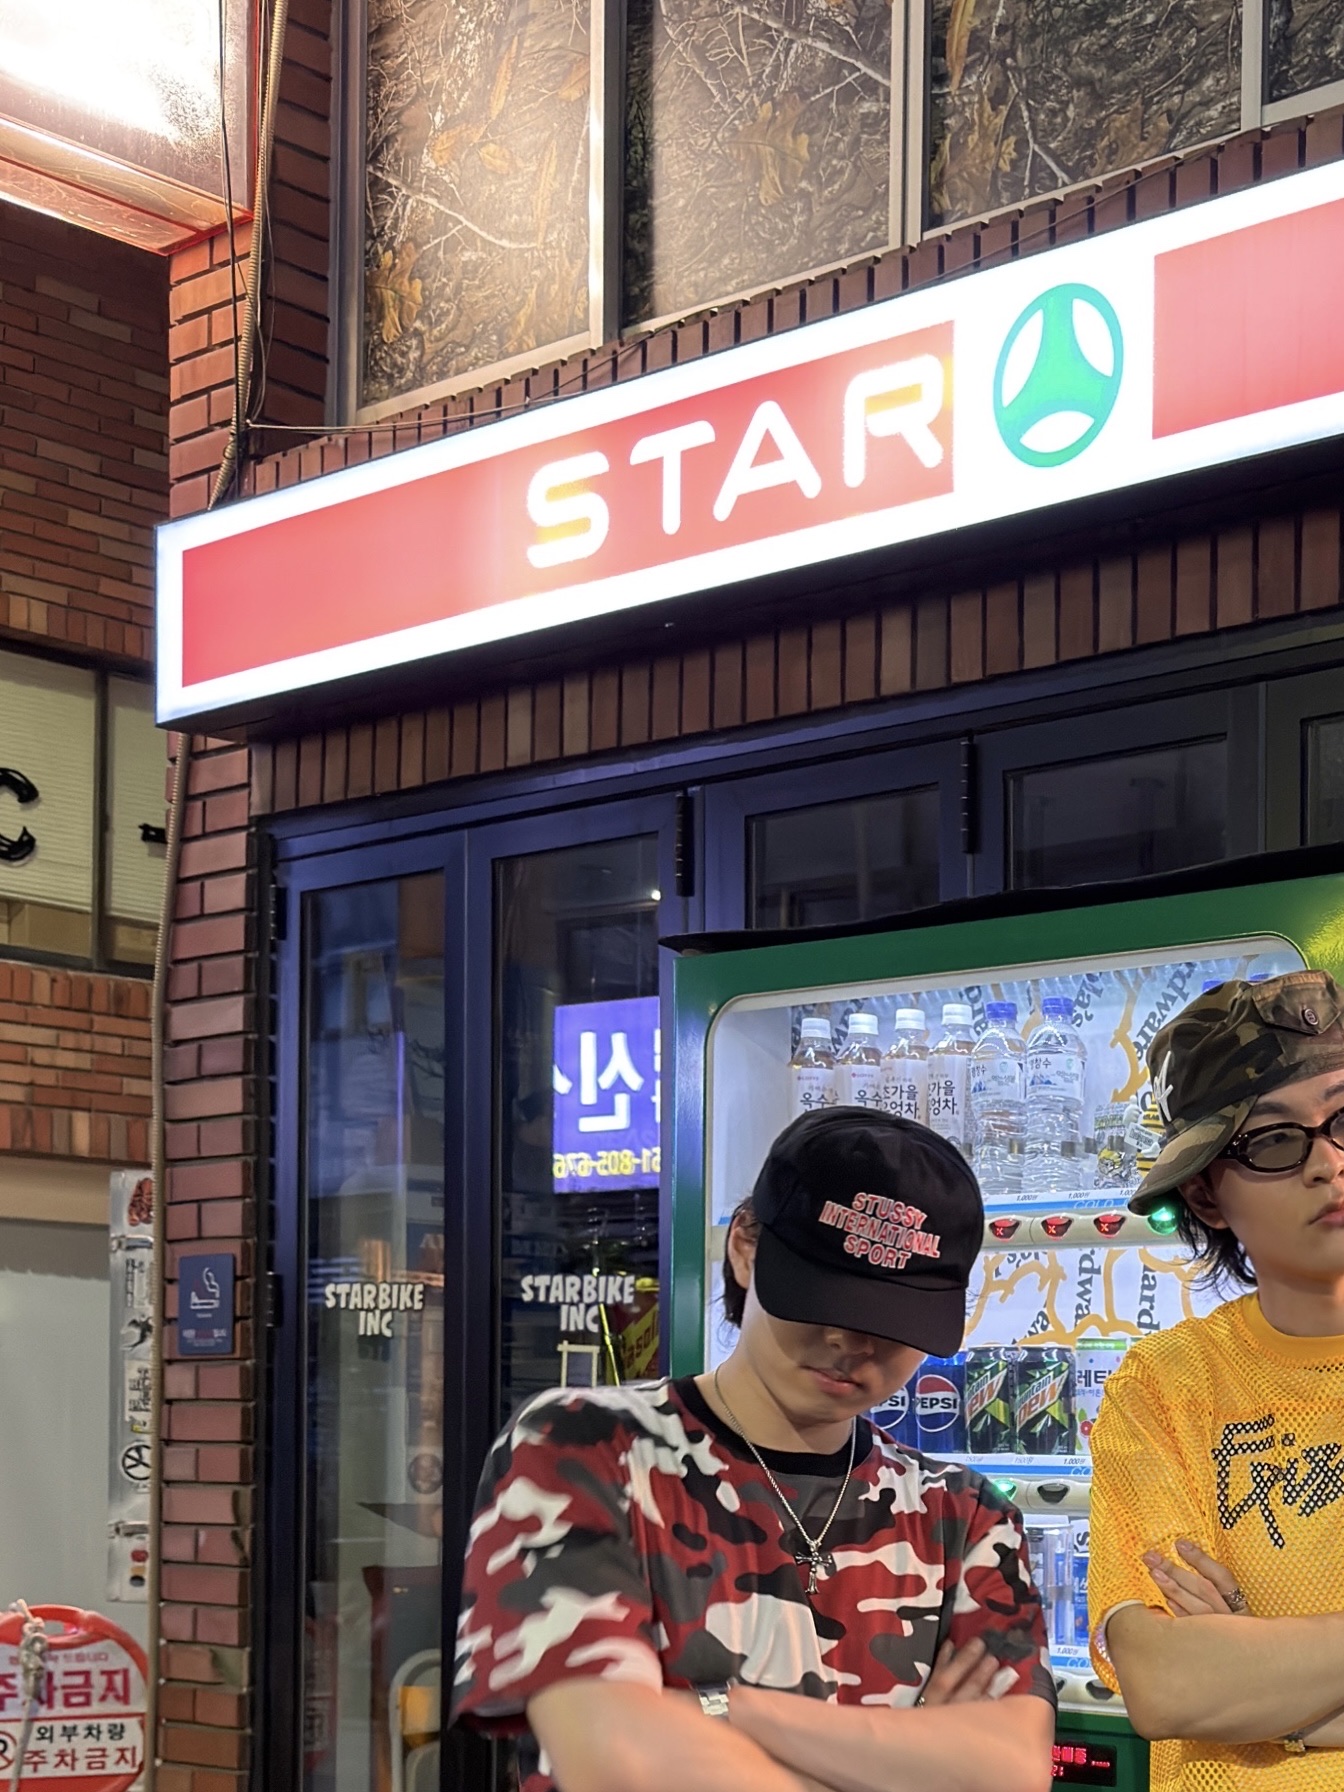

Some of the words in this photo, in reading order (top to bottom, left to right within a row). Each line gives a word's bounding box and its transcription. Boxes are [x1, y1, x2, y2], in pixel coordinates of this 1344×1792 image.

[526, 352, 945, 569] STAR
[851, 1191, 928, 1230] STUSSY
[818, 1200, 941, 1259] INTERNATIONAL
[843, 1234, 912, 1269] SPORT
[325, 1283, 424, 1310] STARBIKE
[521, 1275, 635, 1304] STARBIKE
[358, 1311, 393, 1337] INC
[559, 1304, 599, 1332] INC
[36, 1723, 126, 1743] 외부차량
[24, 1746, 137, 1773] 주차금지
